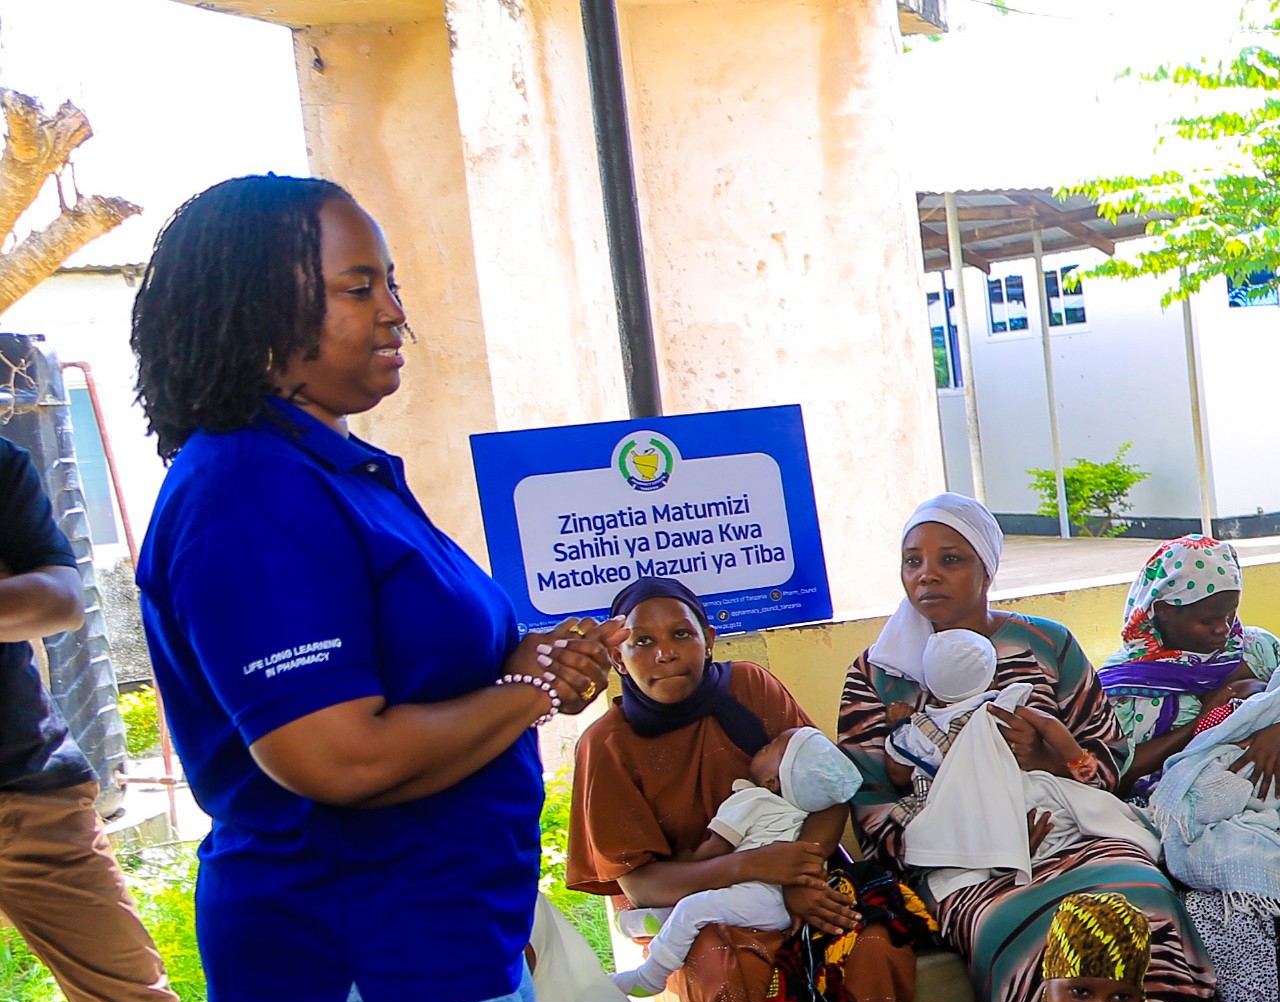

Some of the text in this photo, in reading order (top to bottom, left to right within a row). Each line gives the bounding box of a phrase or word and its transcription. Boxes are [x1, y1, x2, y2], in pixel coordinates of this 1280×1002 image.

[558, 494, 750, 535] Zingatia Matumizi
[553, 522, 762, 562] Sahihi ya Dawa Kwa
[537, 544, 786, 592] Matokeo Mazuri ya Tiba
[703, 599, 722, 607] armacy
[243, 638, 342, 675] LIFE LONG LEARNING
[265, 652, 330, 679] IN PHARMACY
